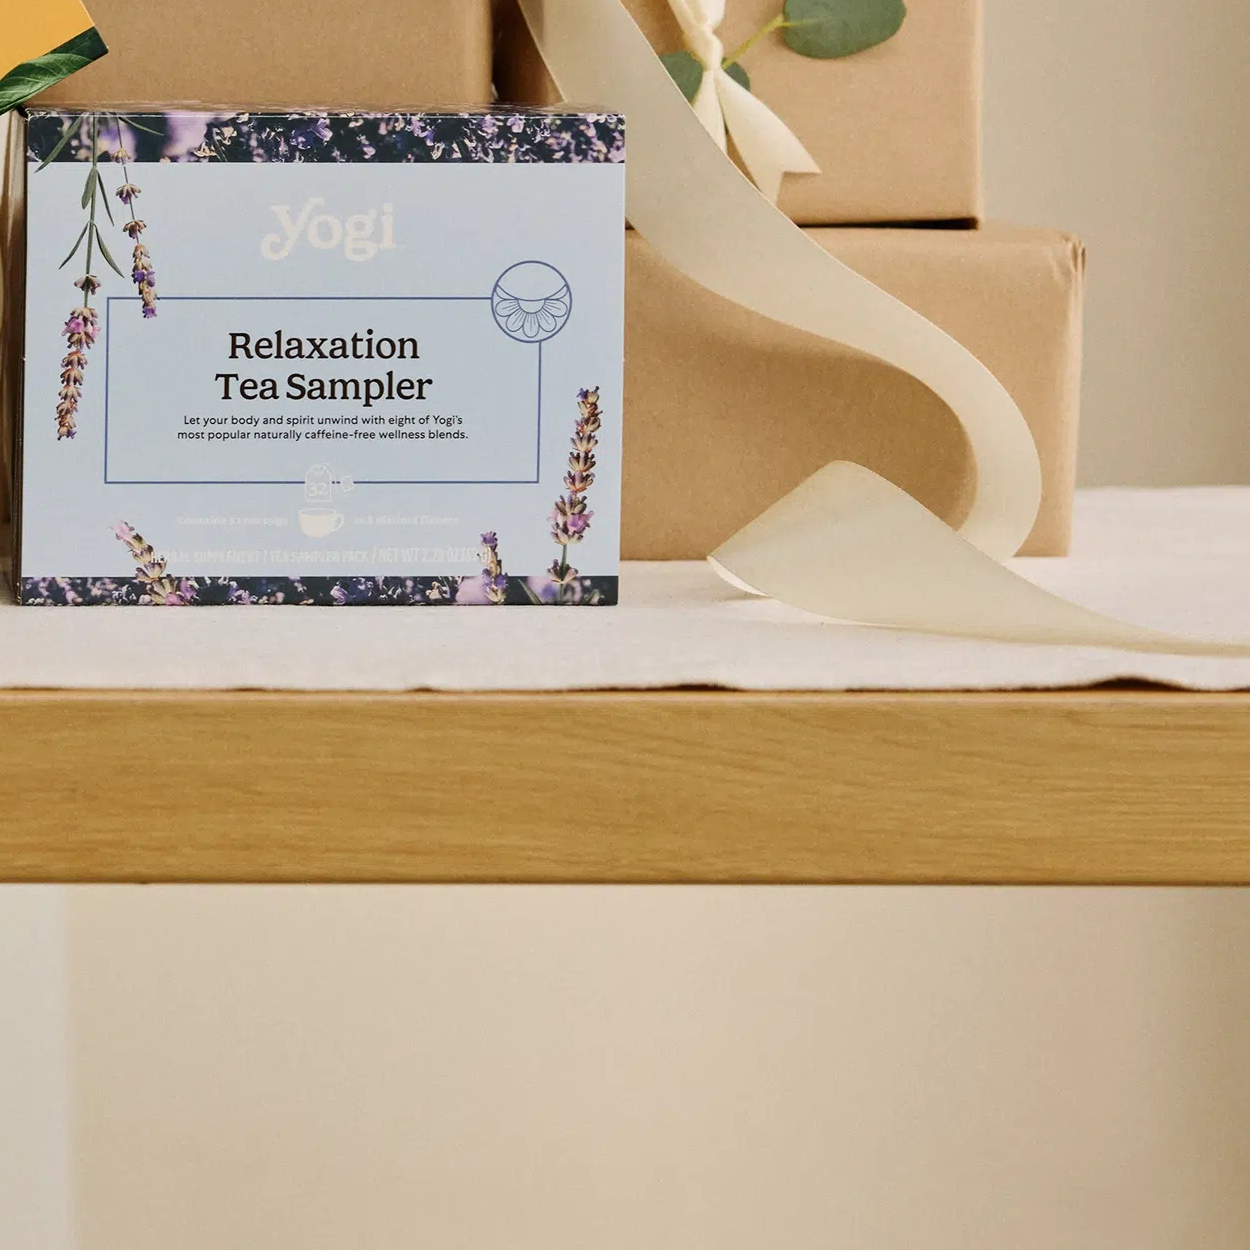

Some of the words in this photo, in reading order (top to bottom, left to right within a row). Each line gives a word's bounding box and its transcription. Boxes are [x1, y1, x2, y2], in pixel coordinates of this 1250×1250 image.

[261, 197, 395, 262] yogi
[228, 328, 421, 360] Relaxation
[214, 373, 280, 401] Tea
[285, 370, 434, 408] Sampler
[183, 415, 201, 426] Let
[202, 417, 229, 428] your
[230, 414, 260, 428] body
[262, 415, 284, 425] and
[285, 414, 315, 428] spirit
[317, 414, 359, 425] unwind
[360, 414, 386, 425] with
[387, 414, 416, 428] eight
[417, 414, 431, 425] of
[432, 414, 463, 428] Yogi's
[177, 431, 205, 440] most
[207, 429, 251, 442] popular
[253, 429, 303, 442] naturally
[304, 429, 376, 440] caffeine-free
[378, 429, 426, 440] wellness
[428, 429, 469, 440] blends.
[307, 482, 329, 497] 32
